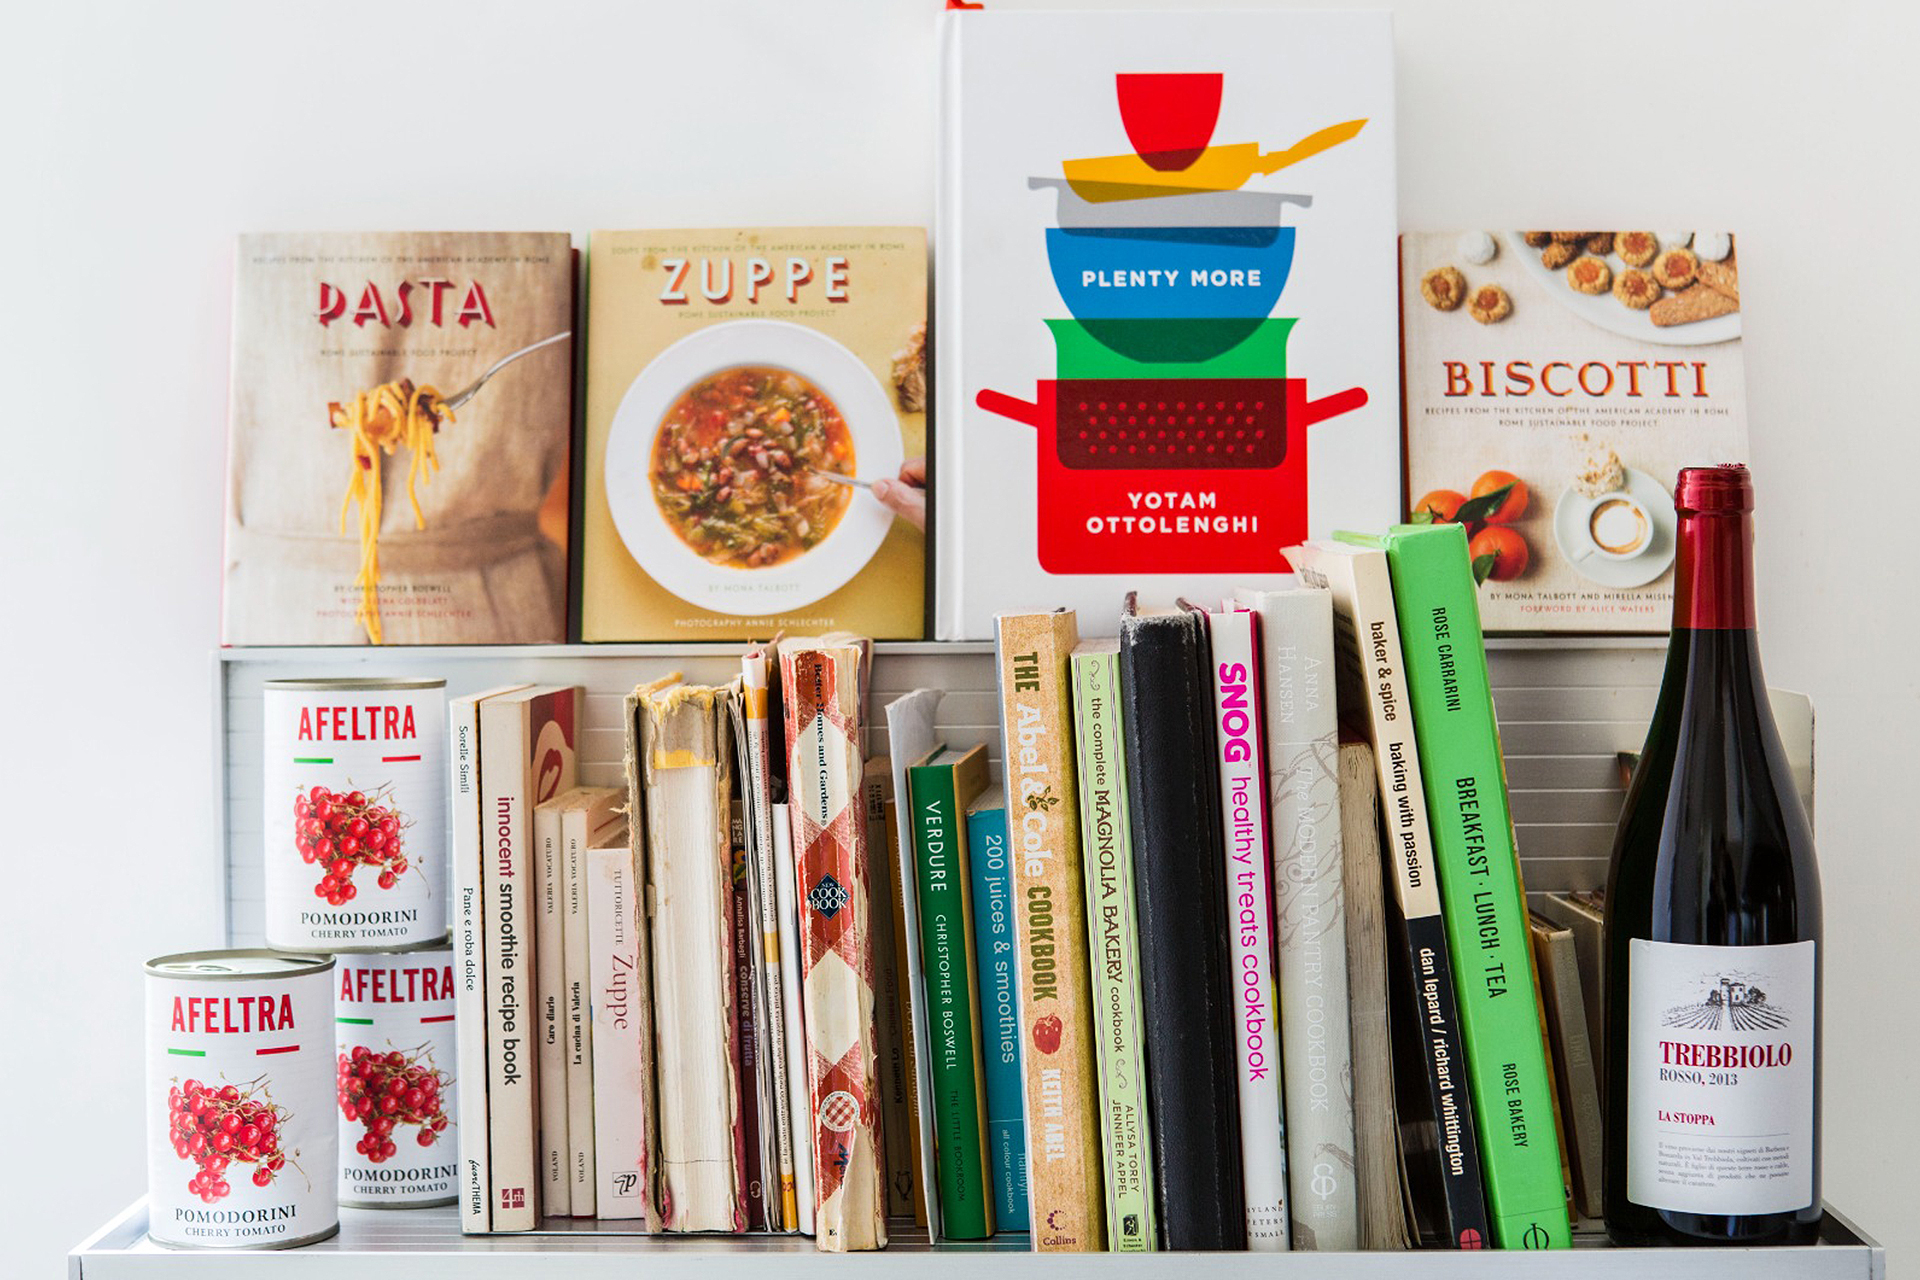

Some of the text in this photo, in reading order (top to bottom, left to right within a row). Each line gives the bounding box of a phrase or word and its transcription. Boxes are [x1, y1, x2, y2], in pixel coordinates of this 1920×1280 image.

[659, 256, 850, 306] ZUPPE
[1081, 269, 1262, 287] PLENTY MORE
[314, 277, 497, 329] PASTA
[1442, 359, 1709, 398] BISCOTTI
[1425, 407, 1460, 415] RECIPES
[1645, 407, 1686, 415] ACADEMY
[1127, 491, 1217, 509] YOTAM
[1086, 516, 1258, 534] OTTOLENGHI
[1520, 605, 1655, 613] FOREWORD BY ALICE WATERS
[1014, 652, 1040, 692] THE
[1370, 621, 1396, 721] baker & spice
[1432, 607, 1461, 712] ROSE CARRARINI
[1278, 646, 1296, 723] HANSEN
[1304, 656, 1323, 711] ANNA
[298, 705, 417, 741] AFELTRA
[816, 702, 825, 742] Homes
[1017, 703, 1048, 774] Abel
[459, 725, 469, 793] Sorelle Simili
[818, 745, 827, 766] and
[1388, 742, 1421, 888] baking with passion
[926, 801, 946, 891] VERDURE
[1022, 812, 1051, 877] Cole
[1091, 698, 1125, 1053] the complete MAGNOLIA BAKERY cookbook
[1456, 777, 1507, 998] BREAKFAST LUNCH TEA
[301, 908, 418, 926] POMODORINI
[464, 887, 474, 916] Pane
[614, 870, 623, 946] TUTTORICETTE
[311, 927, 408, 939] CHERRY TOMATO
[465, 930, 475, 955] roba
[497, 796, 521, 1086] innocent smoothie recipe book
[985, 835, 1016, 1064] 200 juices & smoothies
[1027, 886, 1059, 1001] COOKBOOK
[1232, 777, 1268, 1082] healthy treats cookbook
[1296, 768, 1328, 1112] The MODERN PANTRY COOKBOOK
[341, 965, 455, 1003] AFELTRA
[465, 960, 475, 991] dolce
[1419, 948, 1436, 976] dan
[171, 993, 295, 1034] AFELTRA
[571, 982, 580, 1011] Valeria
[605, 954, 633, 1030] Zuppe
[740, 965, 751, 1017] conserve
[935, 914, 956, 1070] CHRISTOPHER BOSWELL
[1423, 978, 1446, 1025] lepard
[546, 996, 555, 1044] Caro diario
[572, 1014, 581, 1022] di
[573, 1054, 582, 1065] La
[743, 1035, 754, 1066] frutta
[1430, 1038, 1453, 1090] richard
[1659, 1040, 1792, 1068] TREBBIOLO
[1659, 1067, 1738, 1086] ROSSO, 2013
[1041, 1068, 1065, 1163] KEITH ABEL
[1502, 1063, 1528, 1148] ROSE BAKERY
[1658, 1110, 1716, 1126] LA STOPPA
[1112, 1100, 1127, 1199] JENNIFER APPEL
[1125, 1105, 1139, 1193] ALLYSA TOREY
[1438, 1094, 1464, 1176] whittington
[344, 1164, 458, 1182] POMODORINI
[353, 1182, 448, 1195] CHERRY TOMATO
[1002, 1129, 1015, 1214] all colour cookbook
[175, 1204, 297, 1224] POMODORINI
[185, 1223, 286, 1237] CHERRY TOMATO
[1043, 1236, 1077, 1246] Collins
